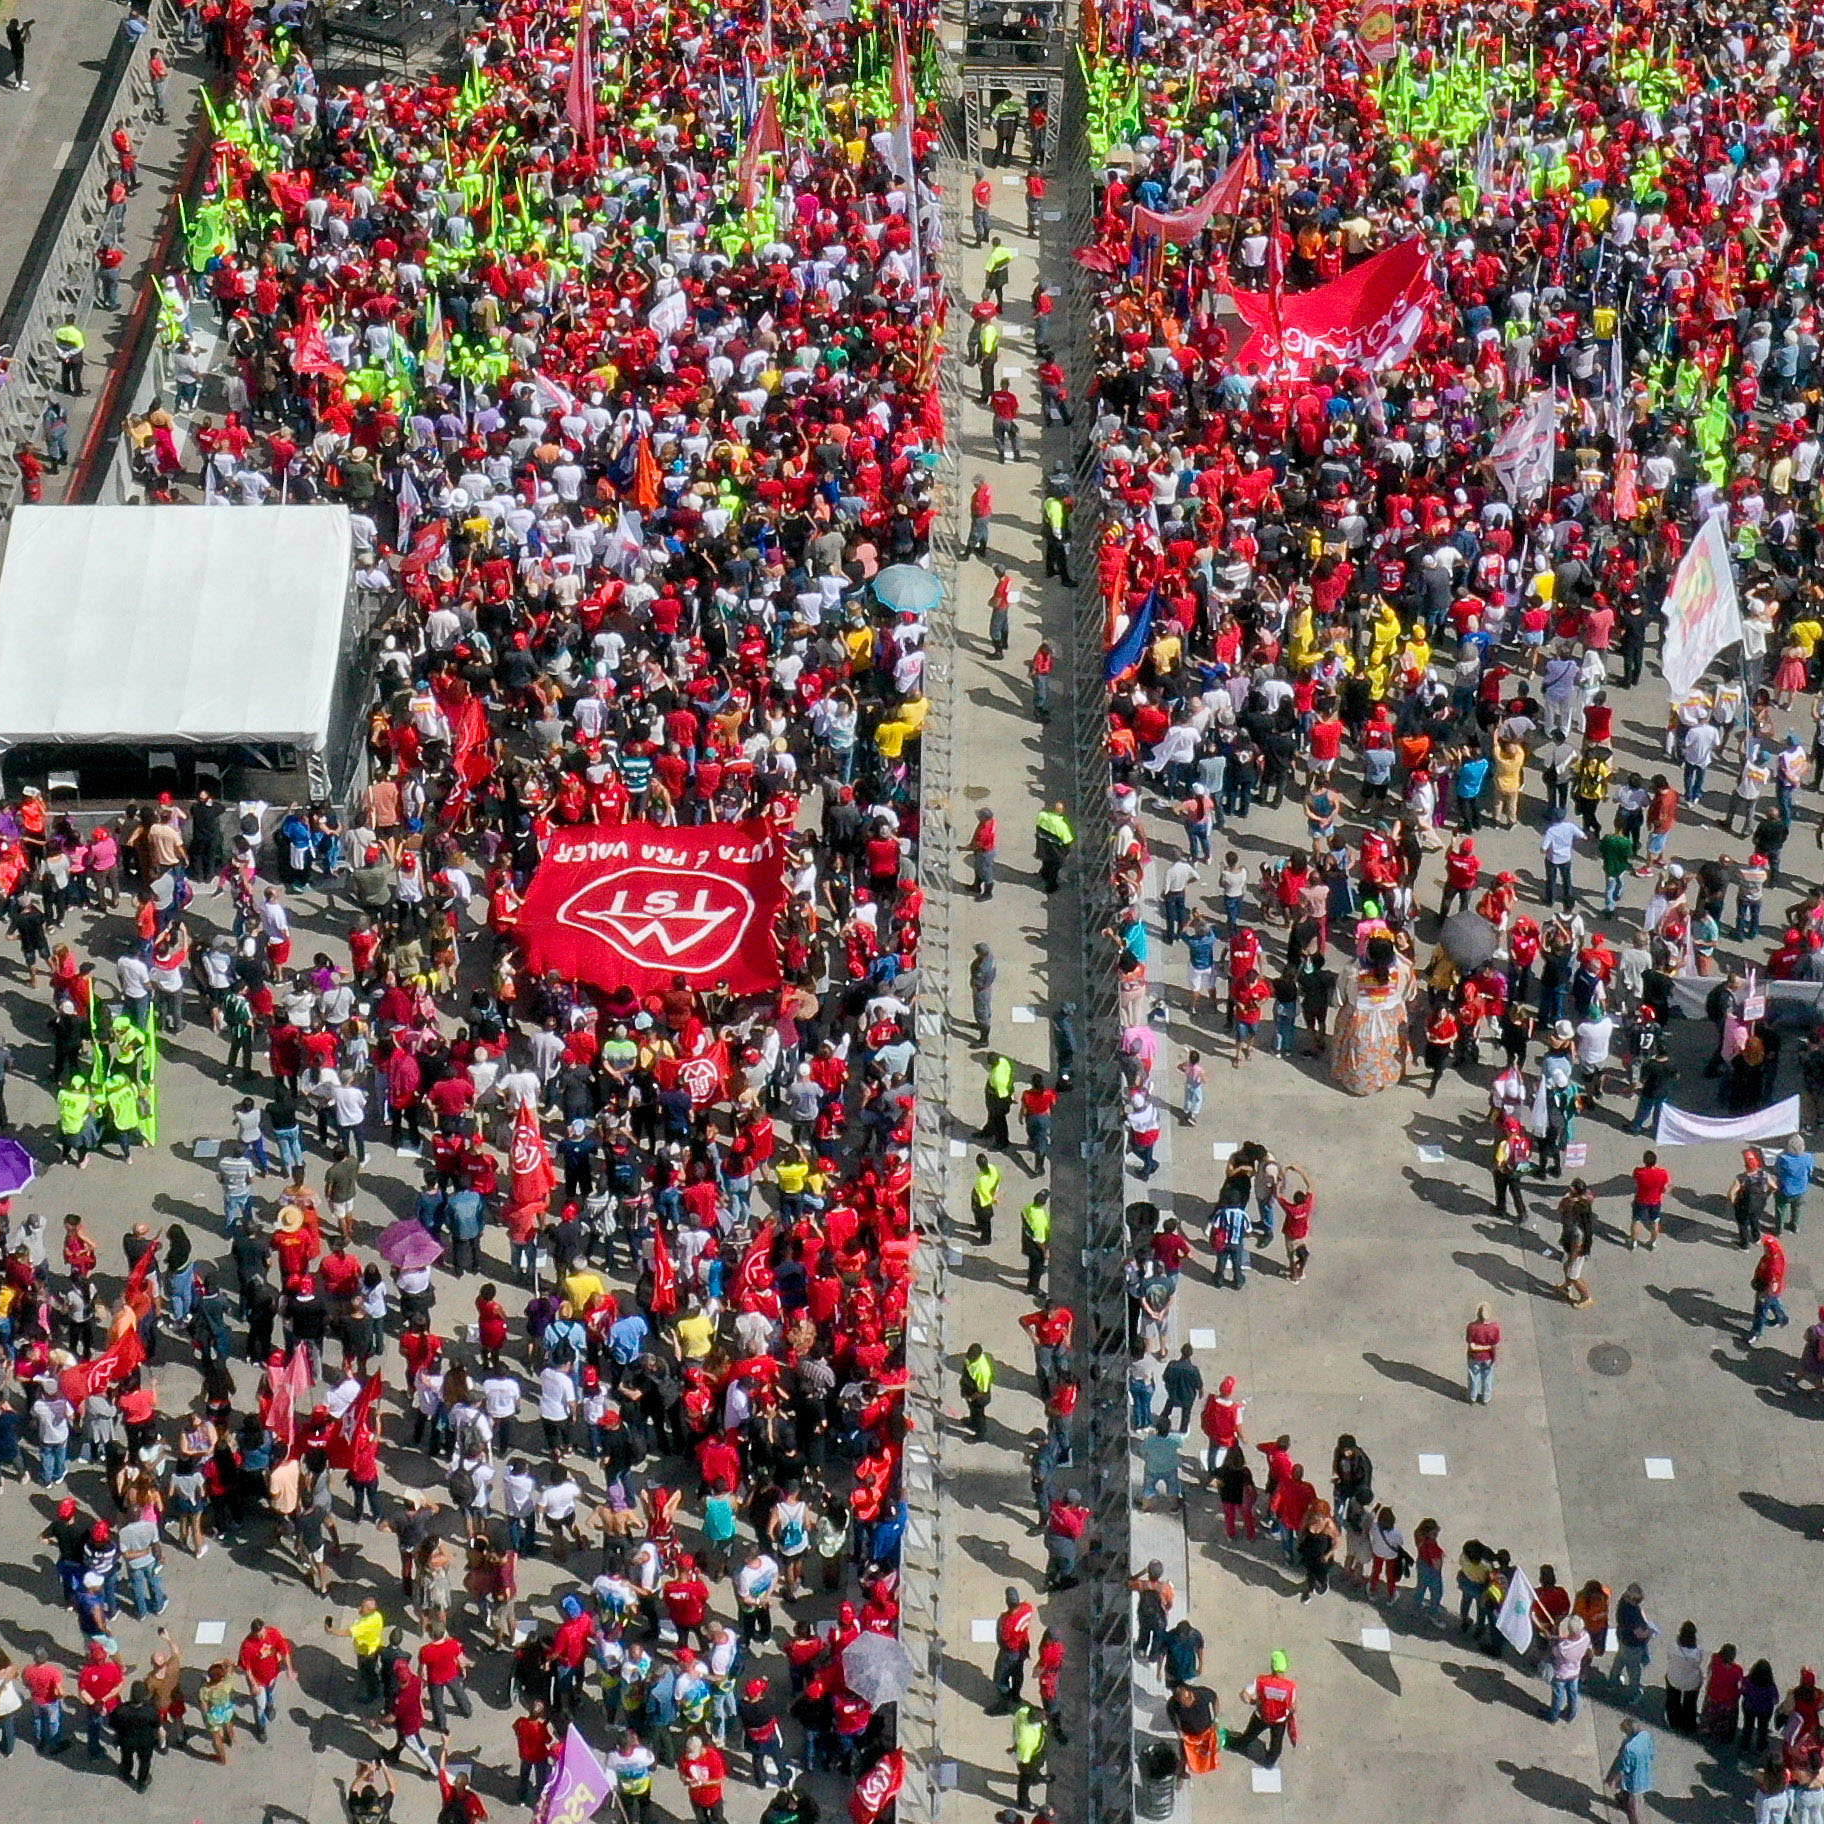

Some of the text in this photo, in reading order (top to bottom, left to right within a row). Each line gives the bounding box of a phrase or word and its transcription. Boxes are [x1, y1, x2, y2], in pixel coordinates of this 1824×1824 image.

[553, 840, 629, 864] VALER
[641, 844, 688, 865] PRA
[717, 837, 774, 864] LUTA
